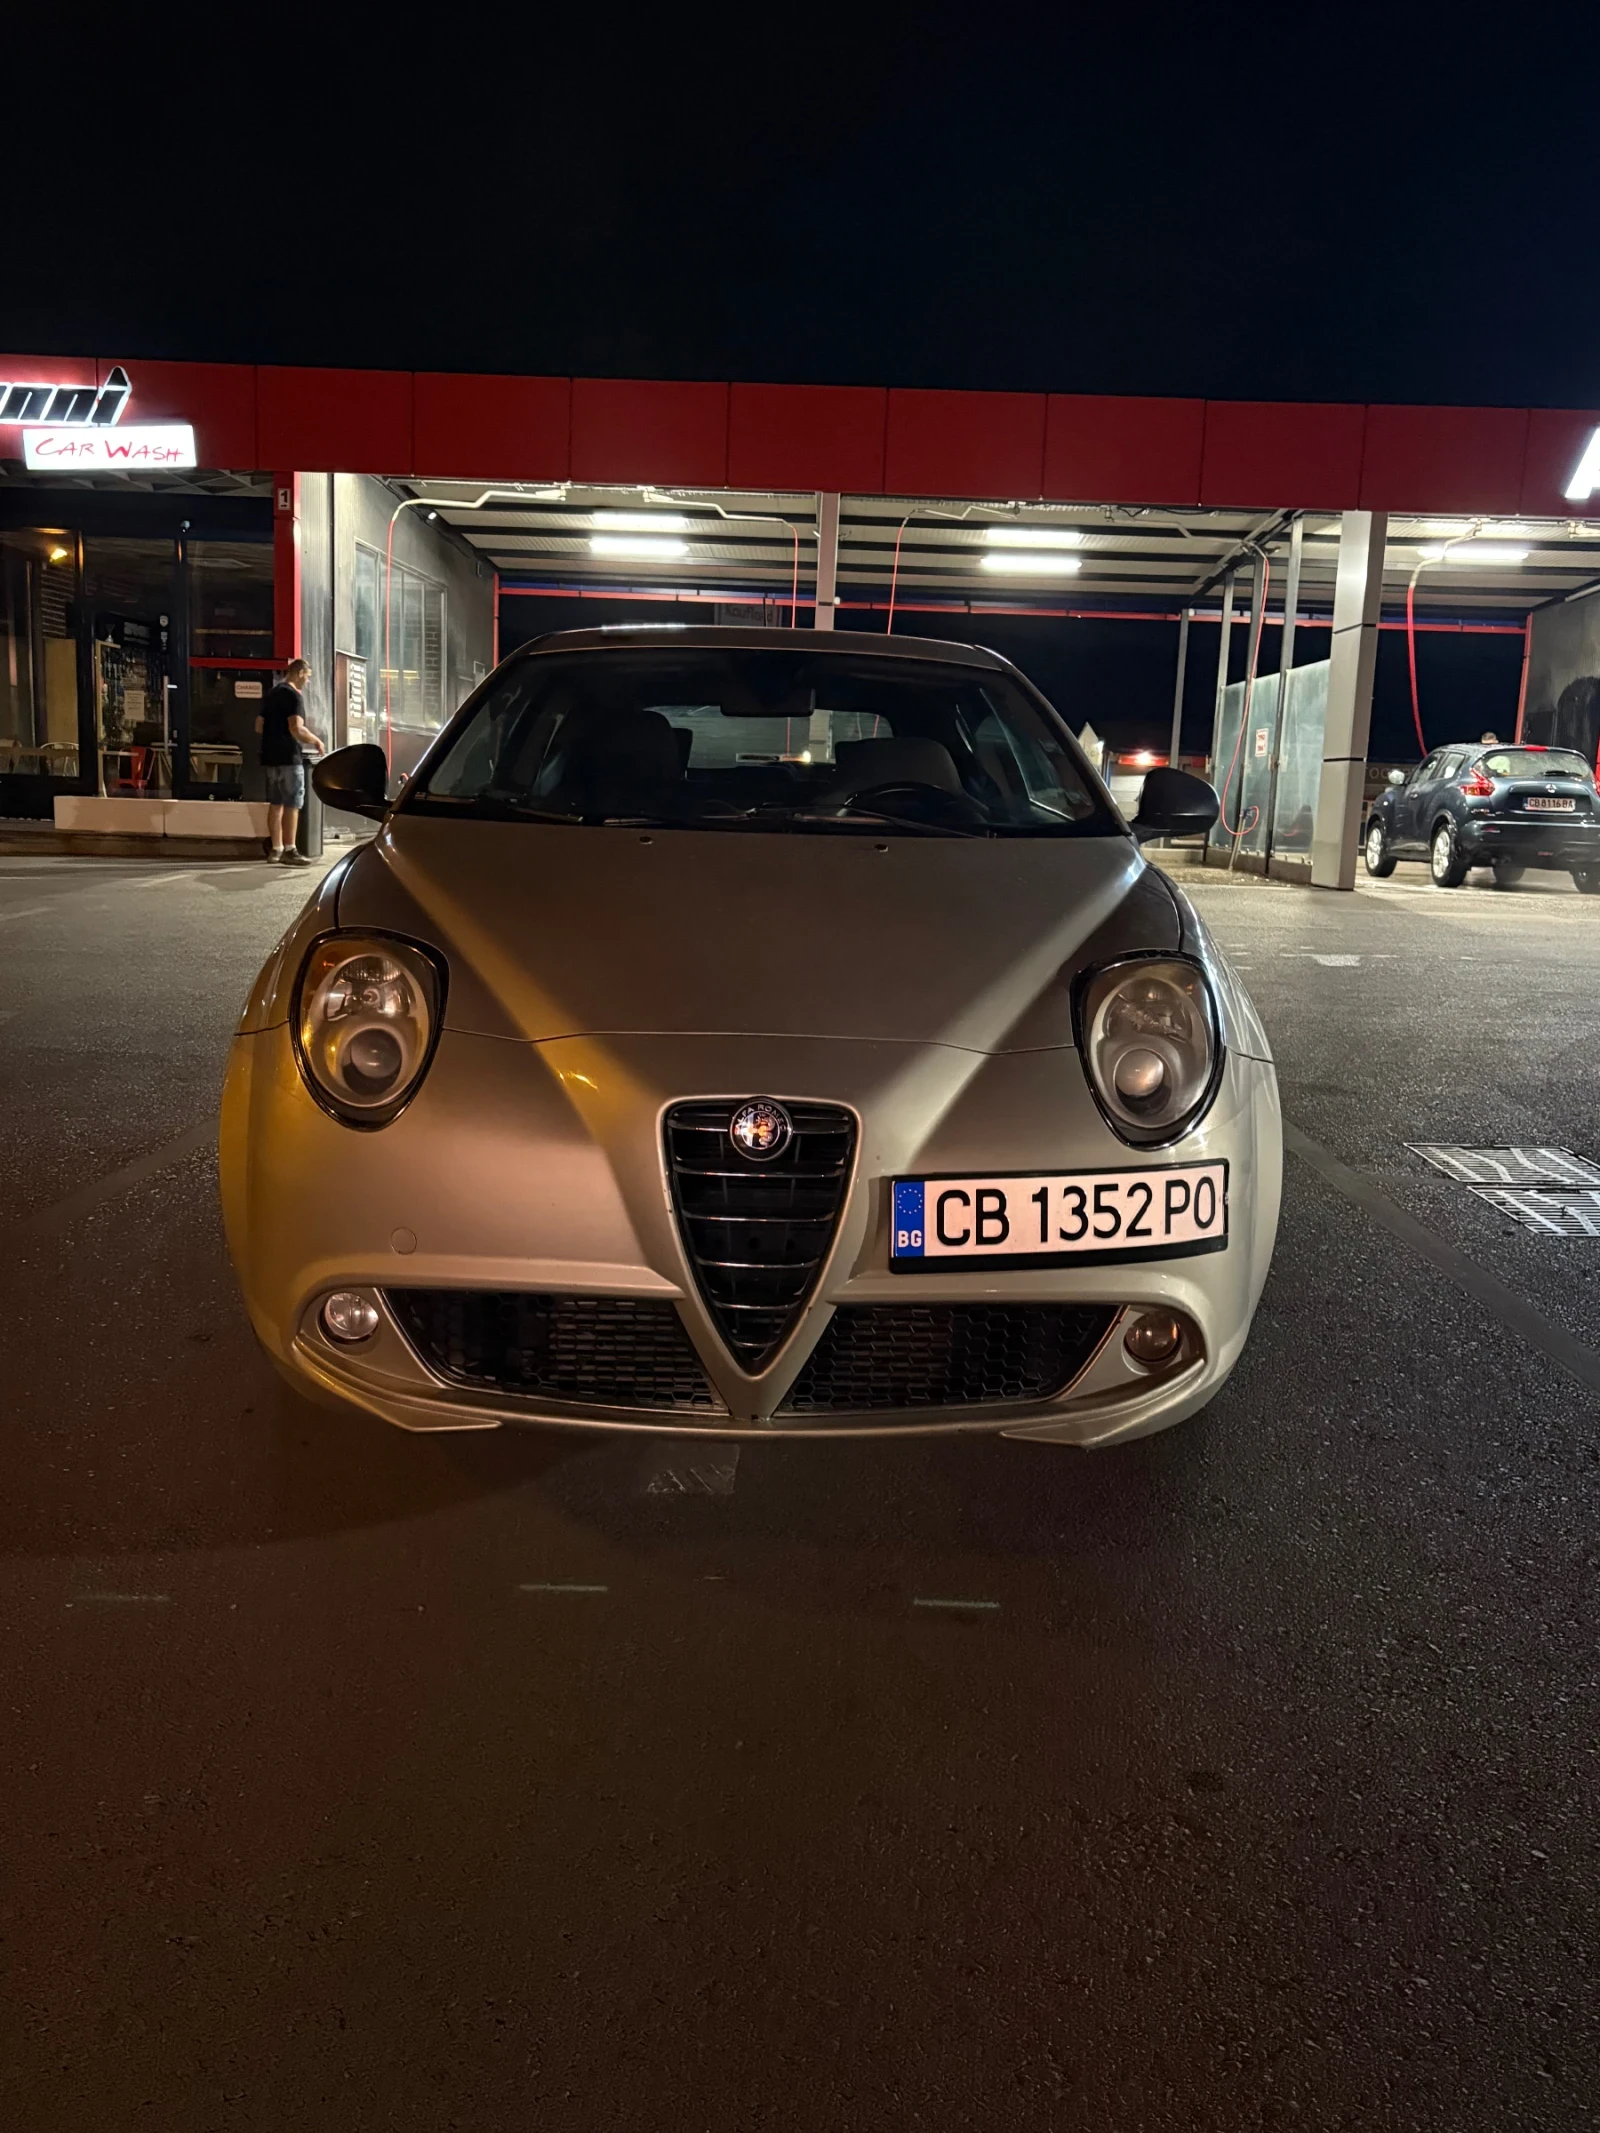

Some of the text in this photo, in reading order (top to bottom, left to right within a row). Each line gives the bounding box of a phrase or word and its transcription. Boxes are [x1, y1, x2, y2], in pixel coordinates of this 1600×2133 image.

[35, 437, 184, 463] CAR WASH
[936, 1188, 1010, 1247] CB
[1031, 1182, 1153, 1243] 1352
[897, 1229, 923, 1248] BG
